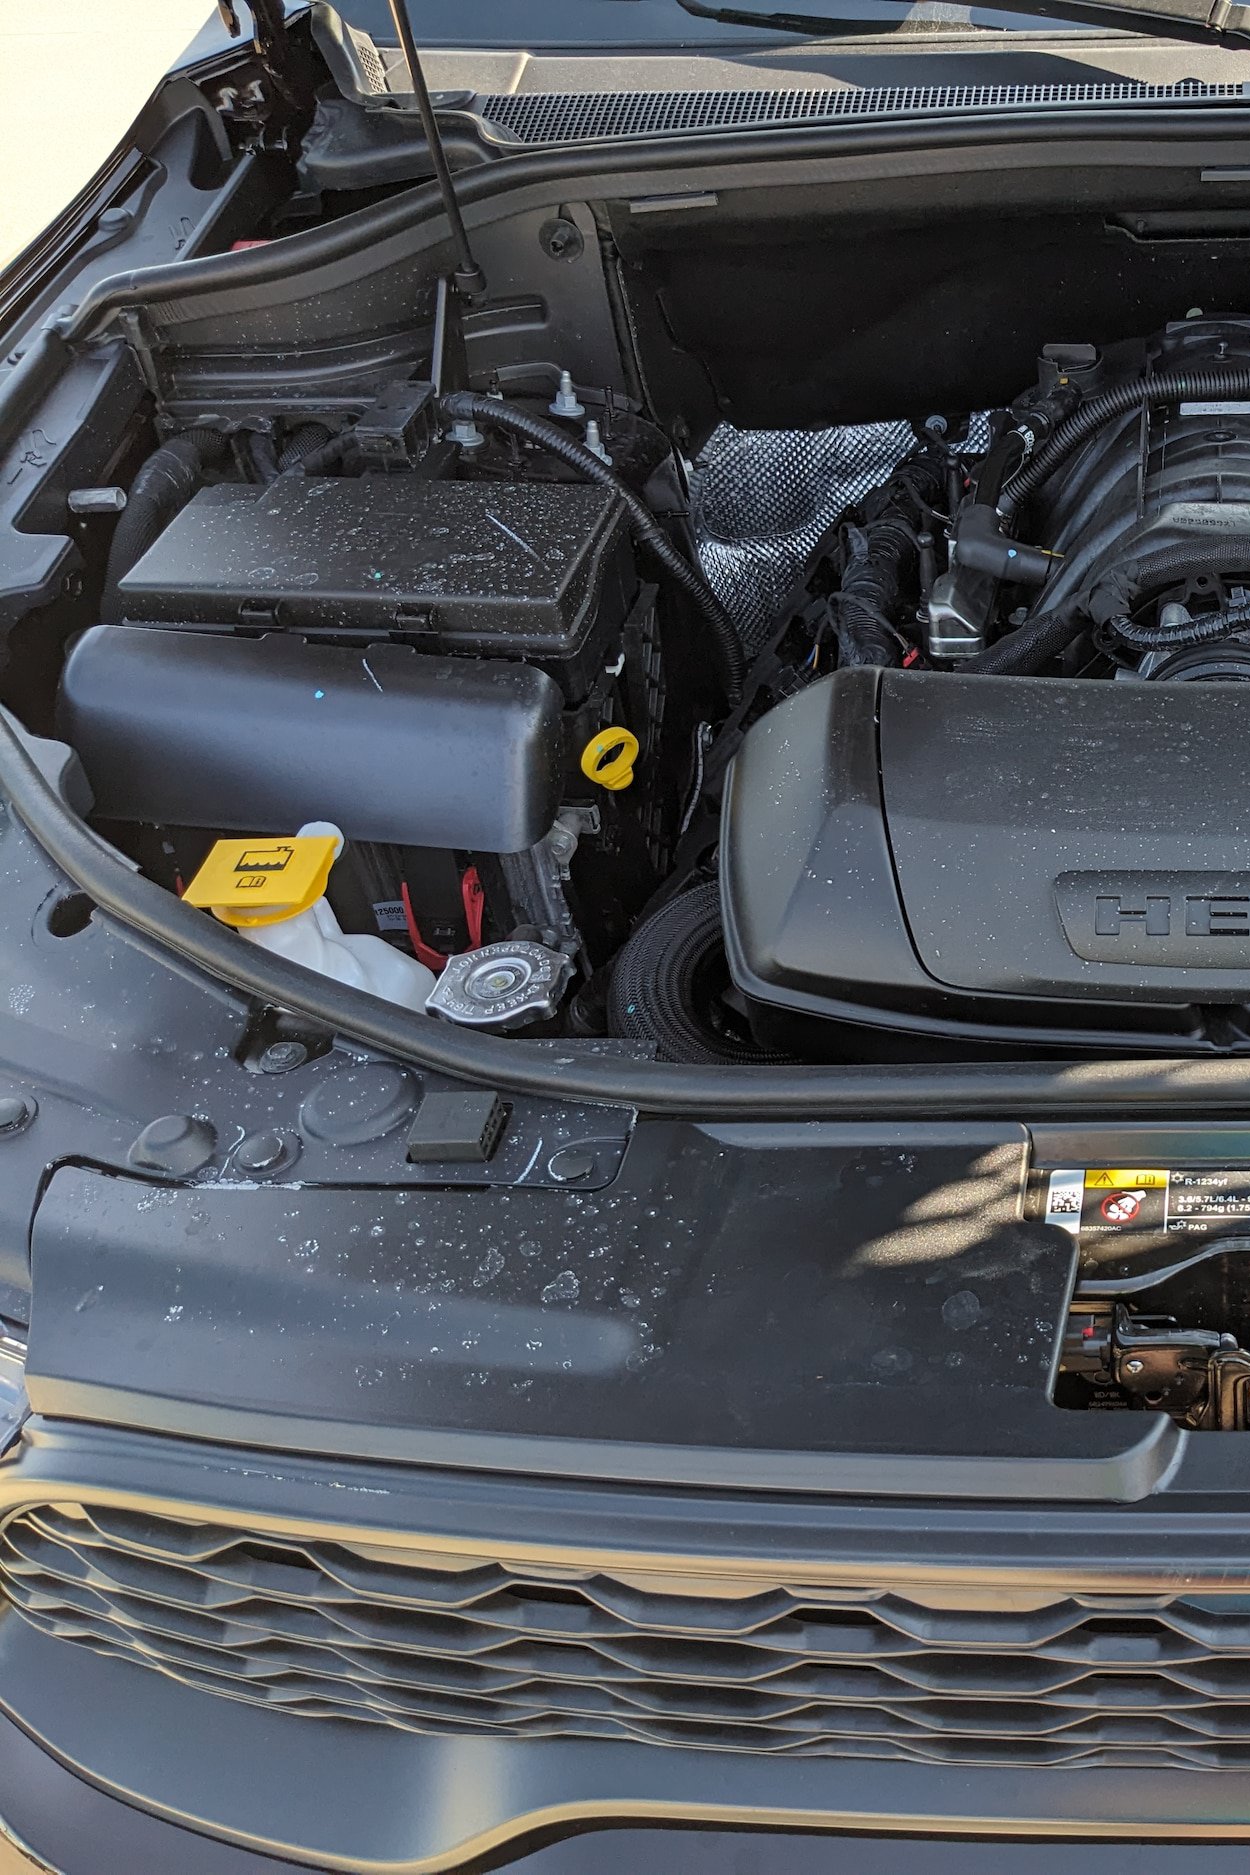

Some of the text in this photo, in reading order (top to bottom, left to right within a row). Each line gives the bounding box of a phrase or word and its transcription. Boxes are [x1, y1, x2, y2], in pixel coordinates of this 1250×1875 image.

[1185, 1178, 1228, 1187] R-1234yf
[1201, 1204, 1225, 1213] 794g
[1226, 1204, 1250, 1213] (1.75
